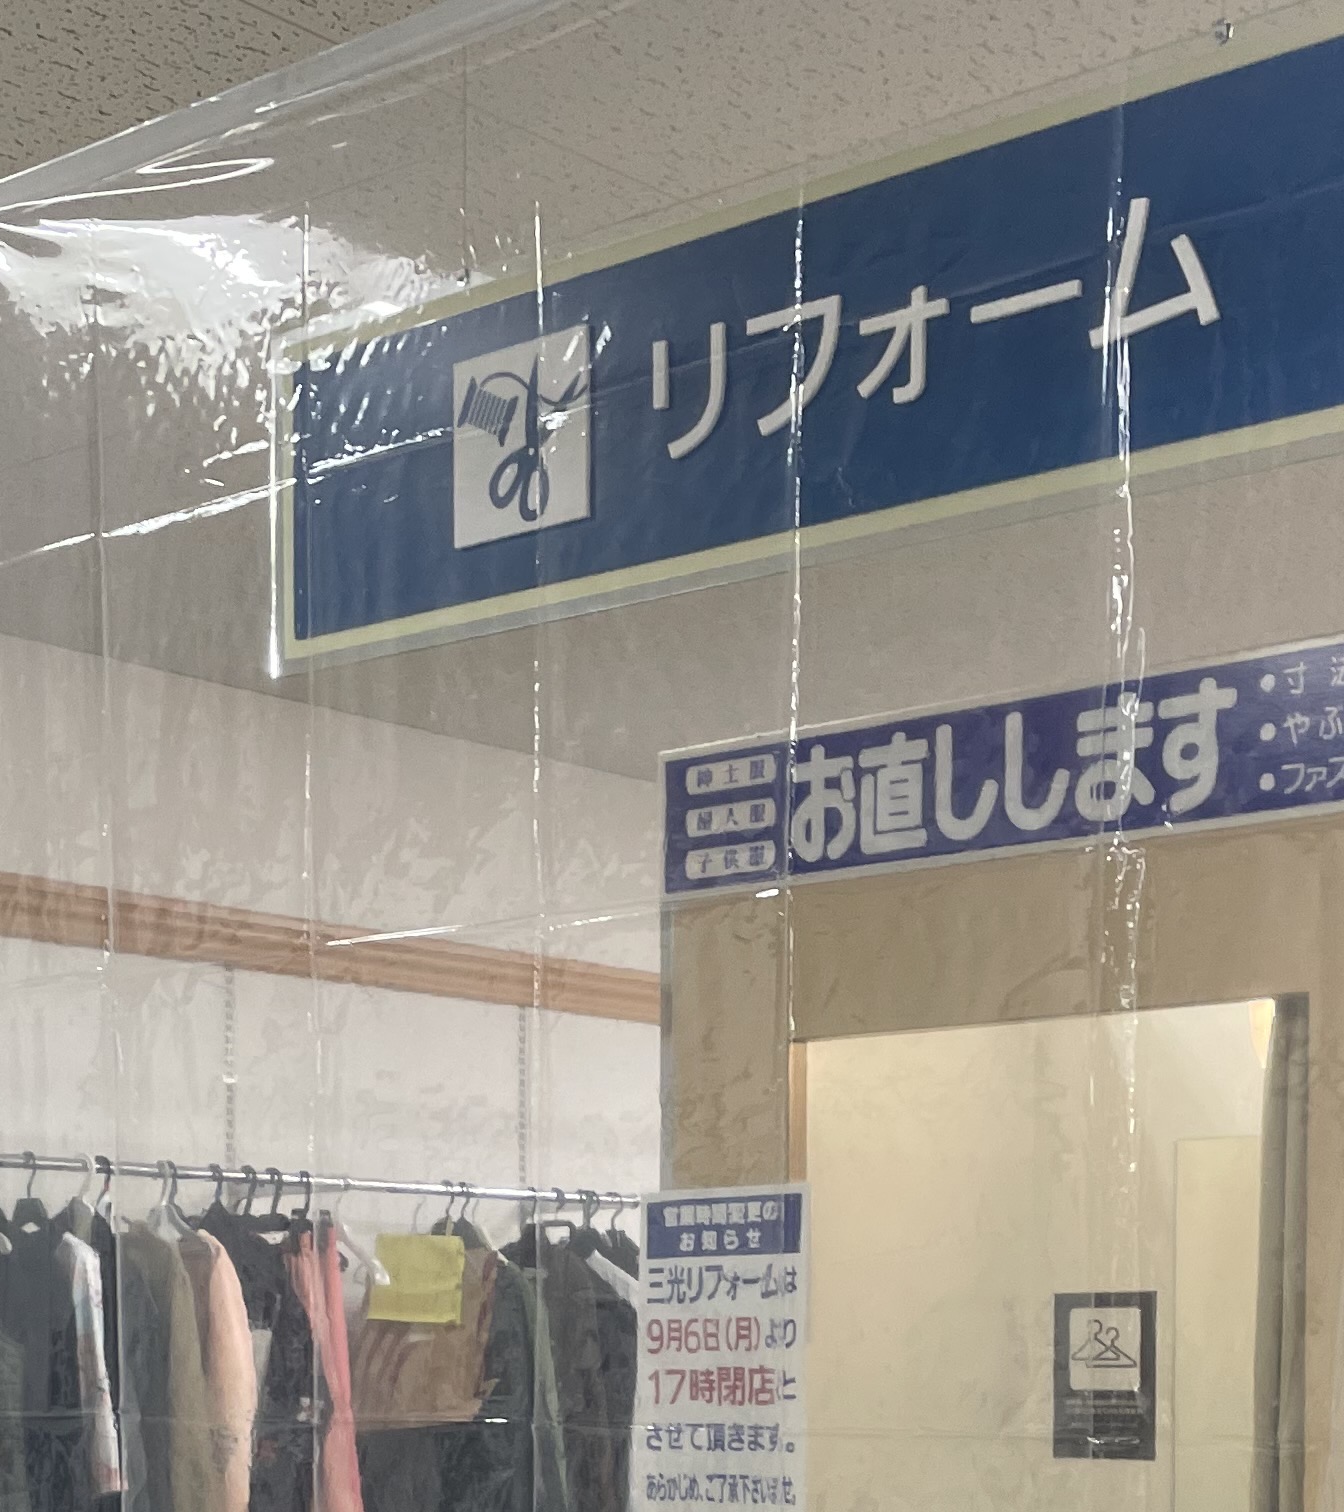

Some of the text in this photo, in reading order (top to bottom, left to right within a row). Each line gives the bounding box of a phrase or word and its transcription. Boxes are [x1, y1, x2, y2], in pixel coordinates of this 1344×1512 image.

[649, 196, 1222, 461] リフォーム
[788, 676, 1238, 864] お直しします
[679, 1228, 763, 1252] お知らせ
[647, 1263, 798, 1305] 三光リフォームは
[647, 1365, 798, 1407] 17時閉店と
